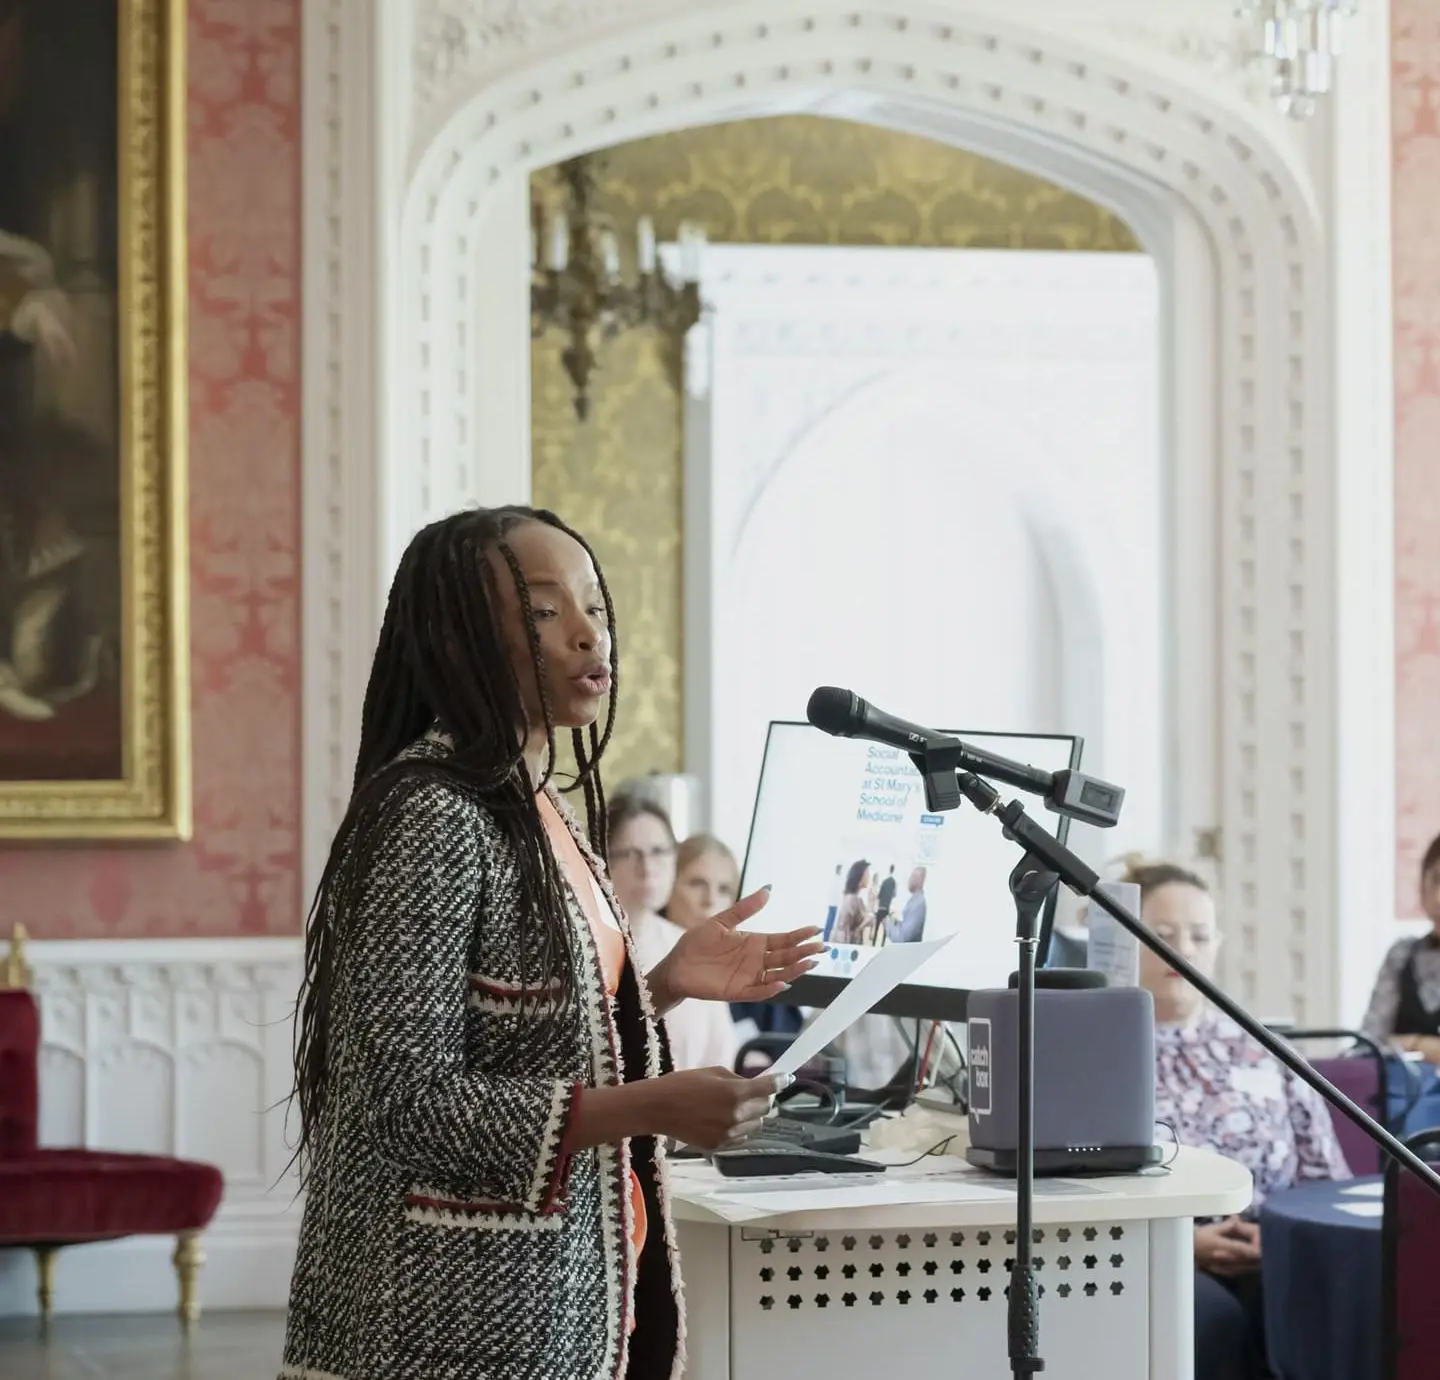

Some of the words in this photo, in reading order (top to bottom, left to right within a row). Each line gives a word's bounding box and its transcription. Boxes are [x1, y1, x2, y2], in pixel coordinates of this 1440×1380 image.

[866, 745, 899, 760] Social
[859, 792, 895, 806] School
[857, 808, 904, 824] Medicine
[970, 1046, 989, 1066] catch
[976, 1066, 989, 1088] box
